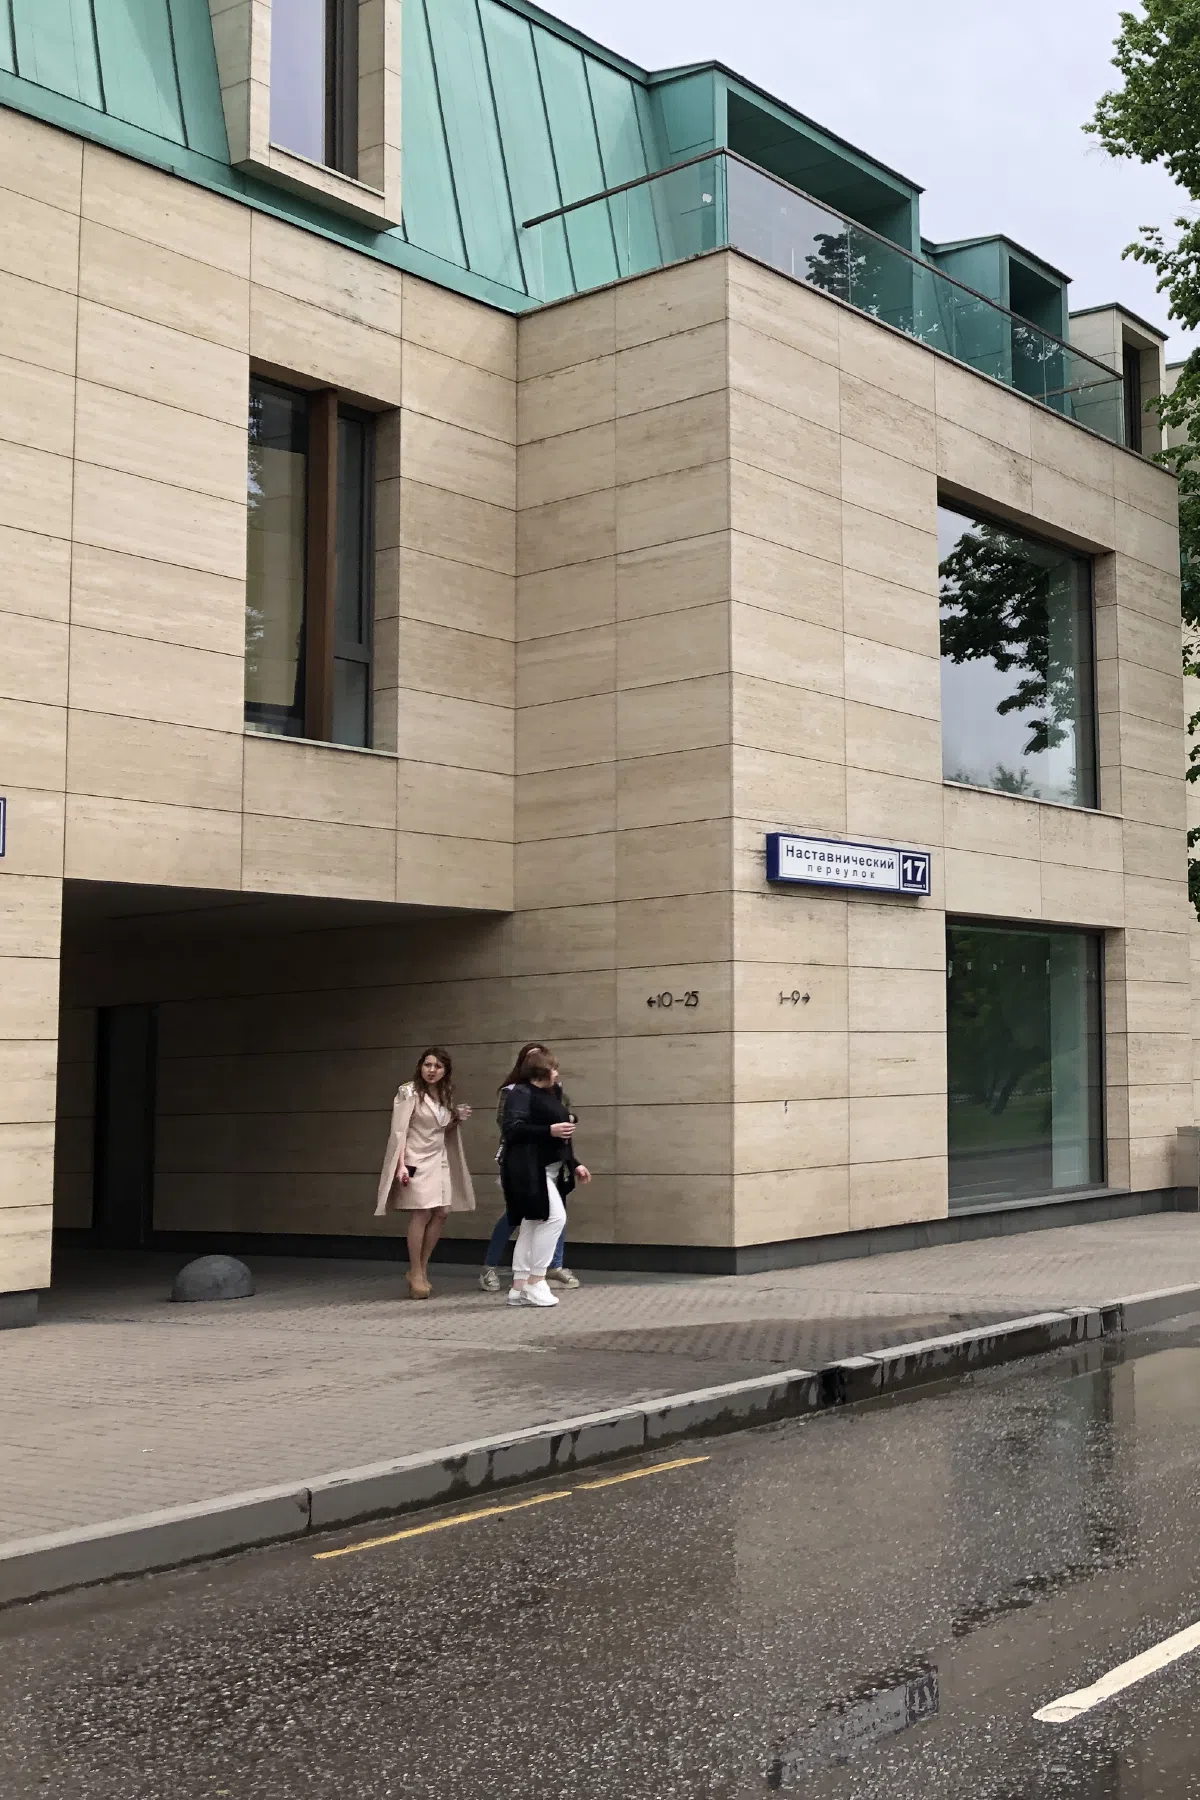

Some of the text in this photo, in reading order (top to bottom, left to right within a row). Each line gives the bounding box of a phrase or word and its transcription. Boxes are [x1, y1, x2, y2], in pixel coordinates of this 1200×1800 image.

[786, 844, 894, 869] Наставнический
[807, 864, 875, 879] переулок
[903, 859, 926, 881] 17
